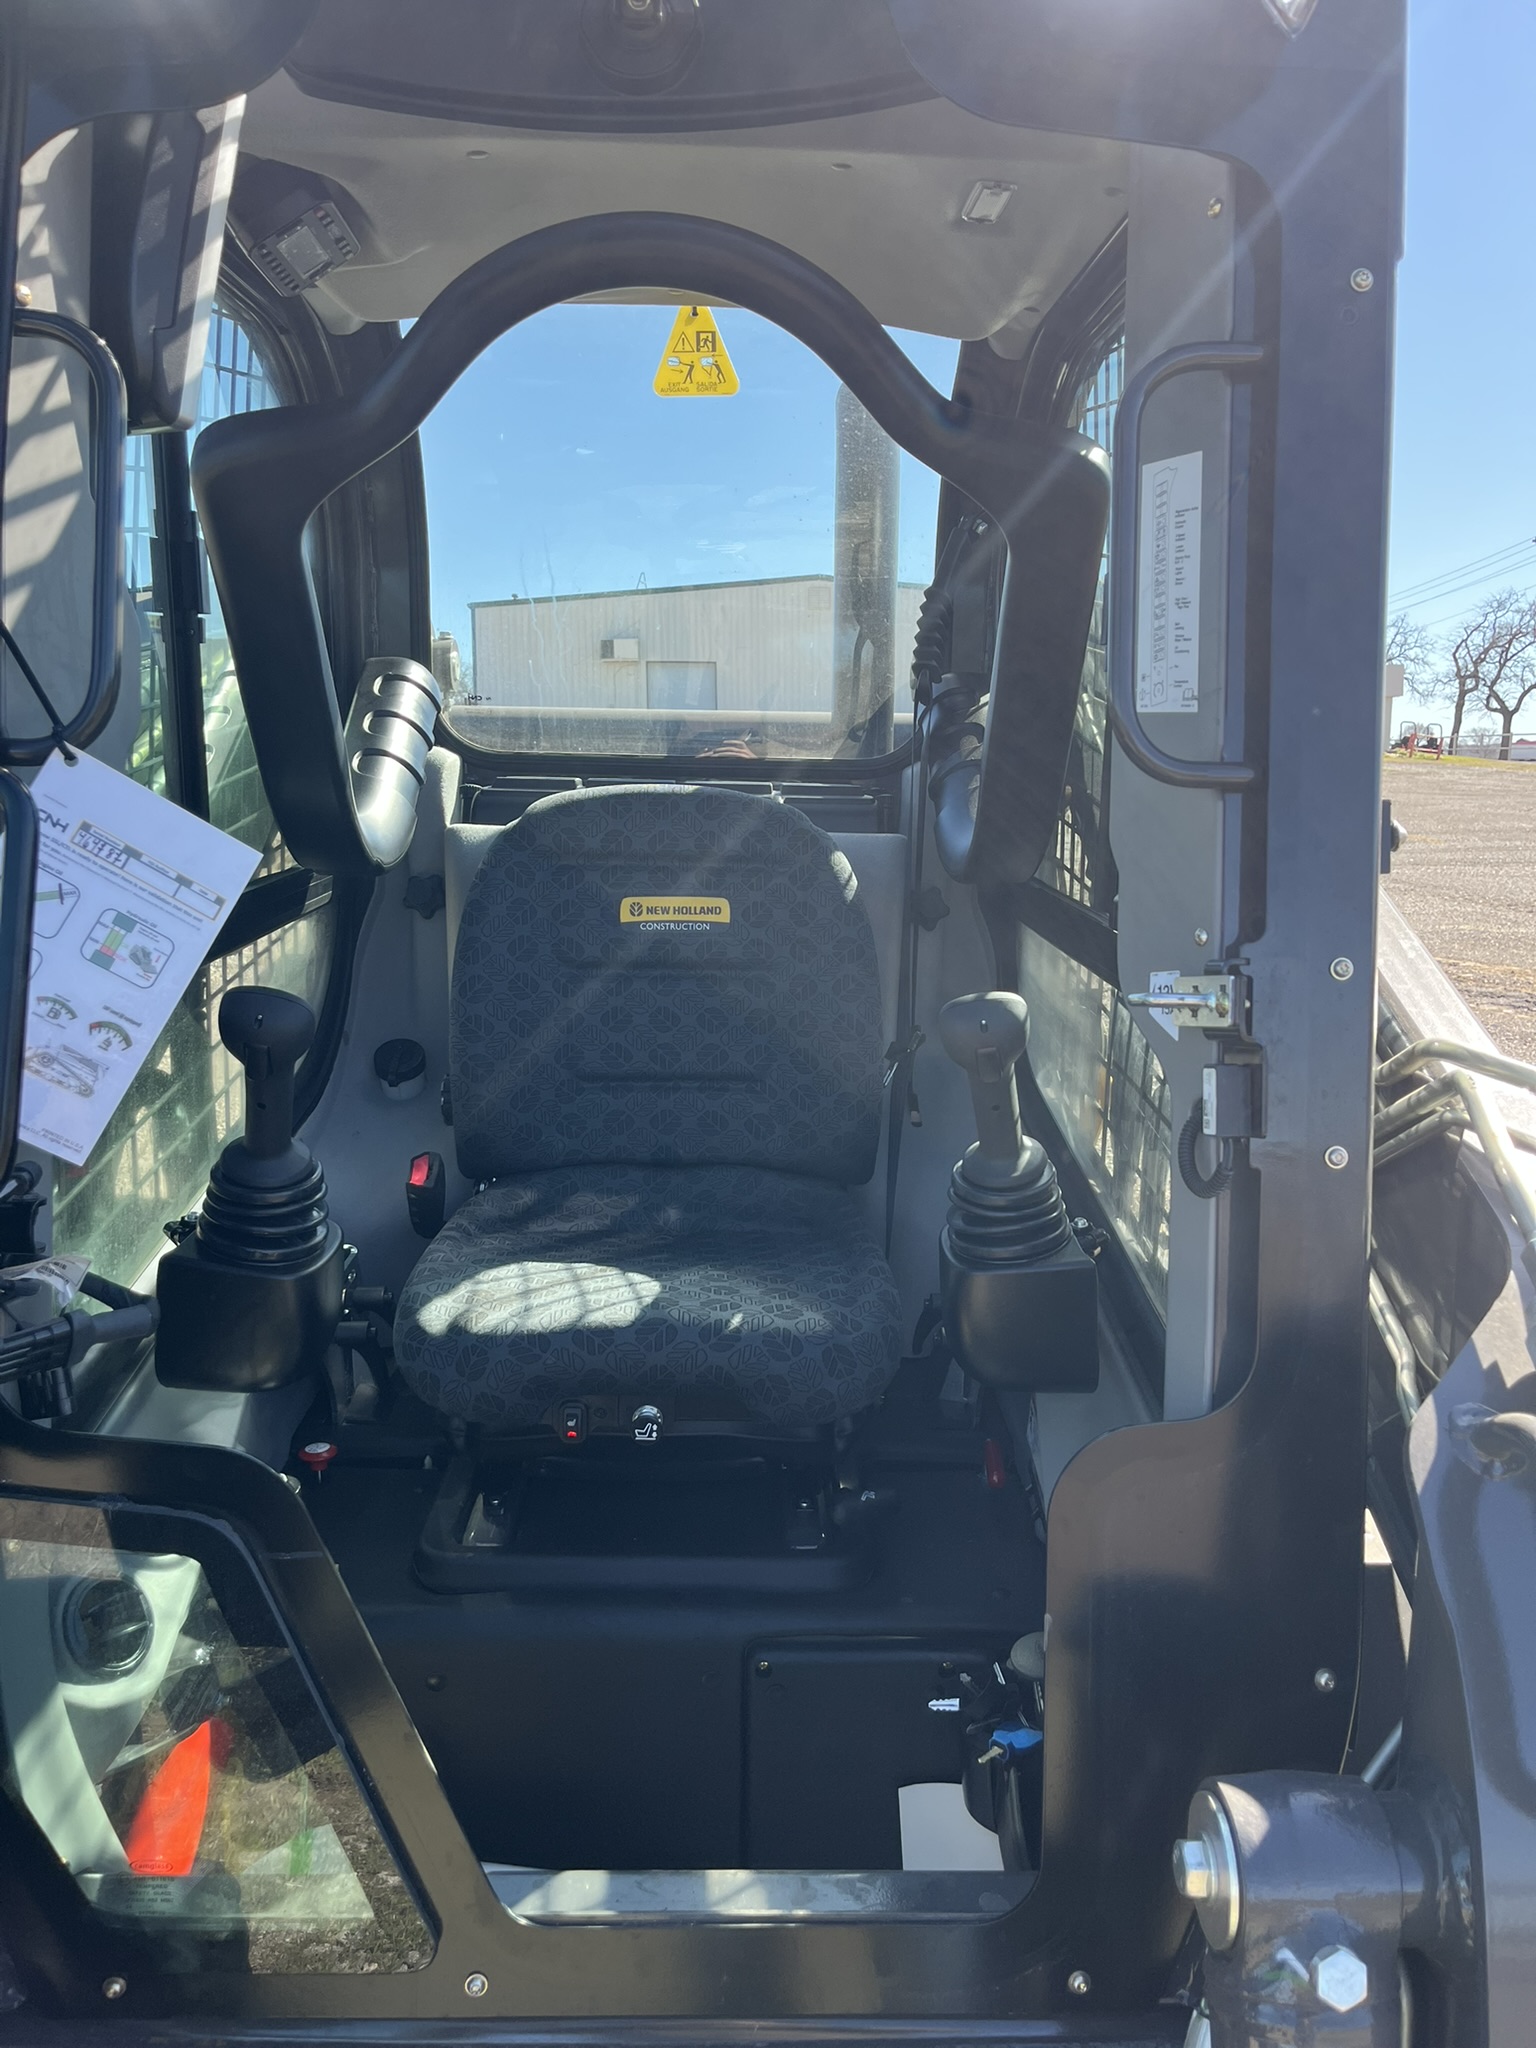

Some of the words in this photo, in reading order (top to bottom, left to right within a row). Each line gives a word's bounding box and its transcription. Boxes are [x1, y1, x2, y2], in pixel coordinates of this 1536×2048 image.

[646, 906, 670, 915] NEW
[673, 906, 722, 916] HOLLAND
[640, 922, 710, 931] CONSTRUCTION
